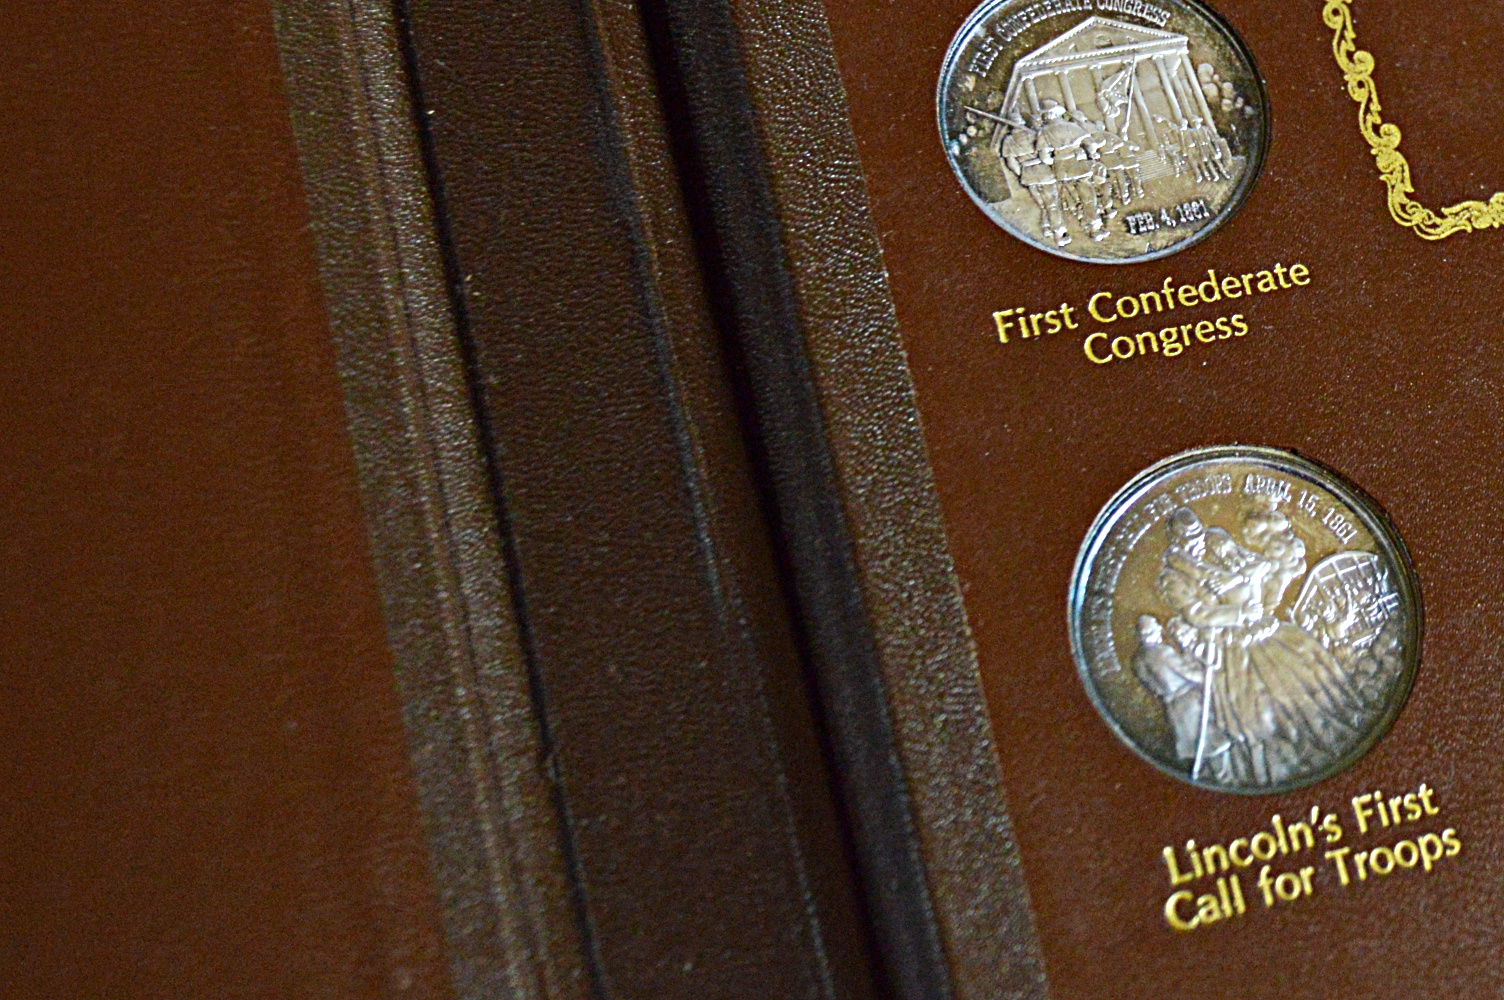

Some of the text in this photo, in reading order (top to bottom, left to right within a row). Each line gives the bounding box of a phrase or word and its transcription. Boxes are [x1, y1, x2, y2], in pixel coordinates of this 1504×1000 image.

[968, 37, 1005, 78] FIRST
[1125, 212, 1159, 234] FEB.
[993, 263, 1311, 344] First Confederate
[1083, 313, 1249, 365] Congress
[1297, 489, 1320, 518] 15,
[1322, 507, 1358, 545] 1861
[1162, 784, 1441, 886] Lincoln's First
[1163, 828, 1462, 931] Call for Troops
